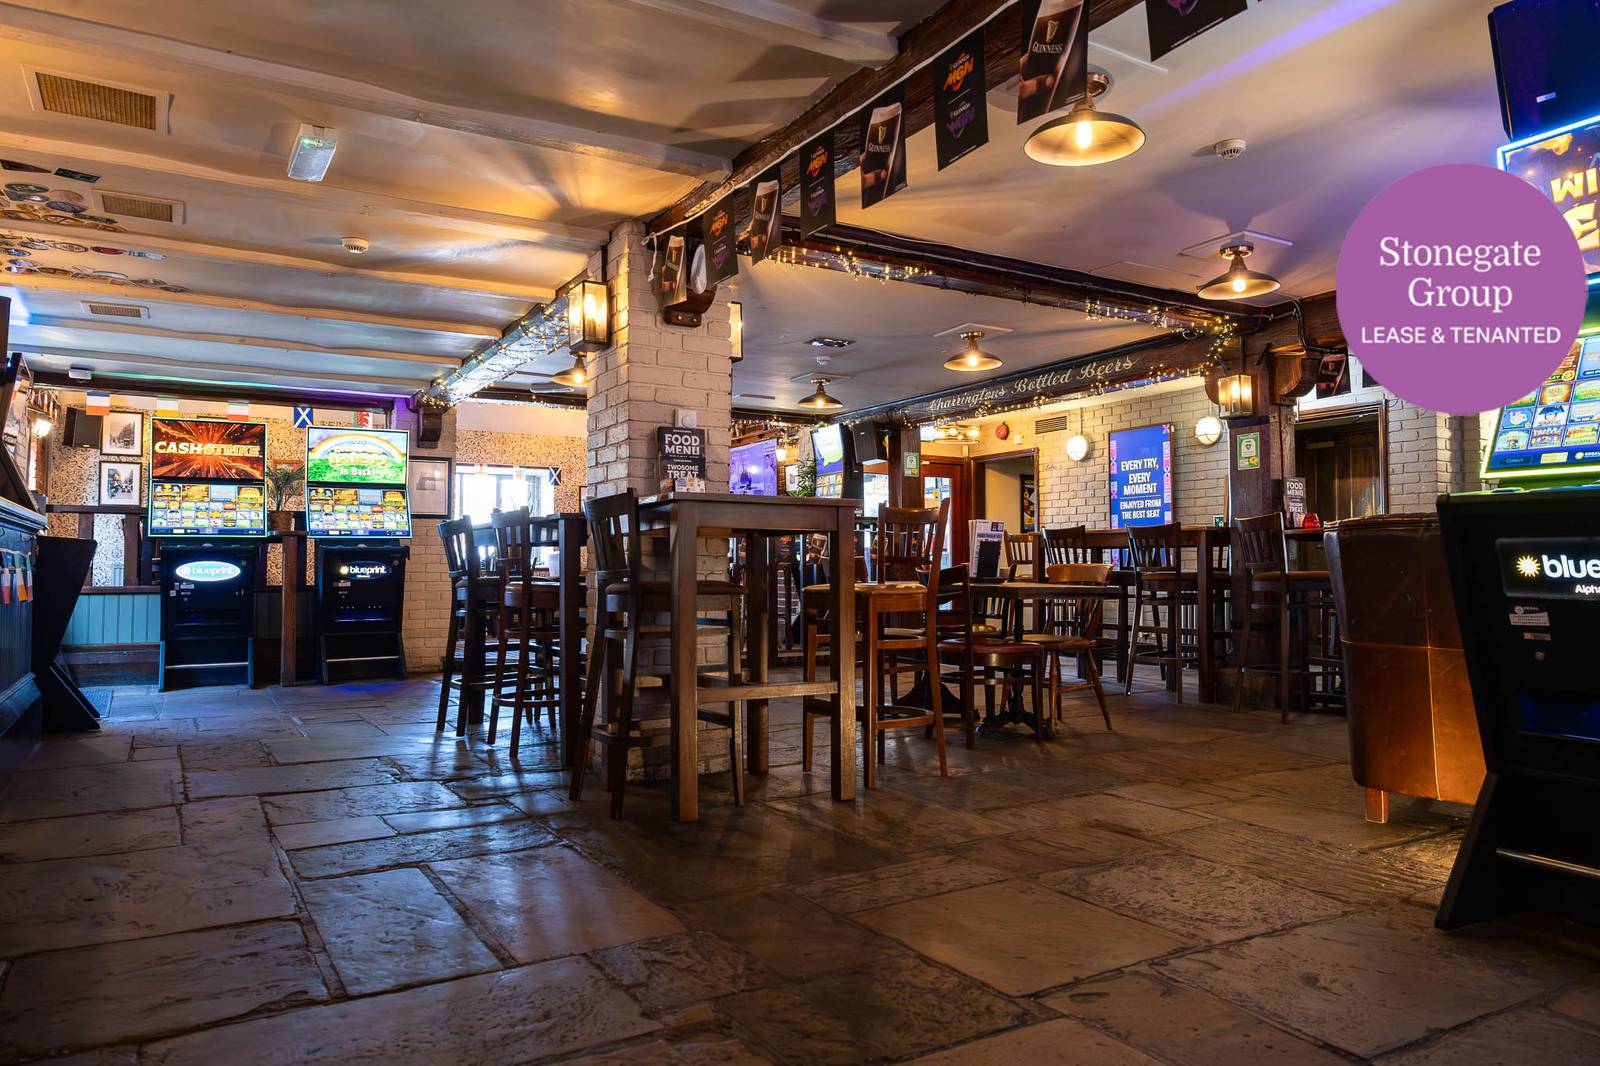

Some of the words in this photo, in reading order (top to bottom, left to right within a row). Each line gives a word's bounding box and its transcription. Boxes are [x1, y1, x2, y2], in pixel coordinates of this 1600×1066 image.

[1032, 41, 1063, 54] GUINNESS
[868, 143, 892, 153] GUINNESS
[1012, 371, 1071, 394] Bottled
[1077, 356, 1140, 380] Beers
[664, 433, 700, 446] FOOD
[154, 441, 200, 455] CASH
[202, 443, 260, 457] STRIKE
[665, 444, 700, 455] MENU
[1121, 459, 1142, 472] EVERY
[1144, 457, 1159, 470] TRY,
[667, 470, 699, 479] TREAT
[1128, 472, 1151, 484] EVERY
[1123, 483, 1157, 496] MOMENT
[1286, 481, 1303, 490] FOOD
[1120, 500, 1145, 510] ENJOYED
[1145, 499, 1162, 509] FROM
[1122, 511, 1132, 520] THE
[1133, 510, 1146, 519] BEST
[1146, 509, 1161, 518] SEAT
[349, 565, 386, 576] blueprint
